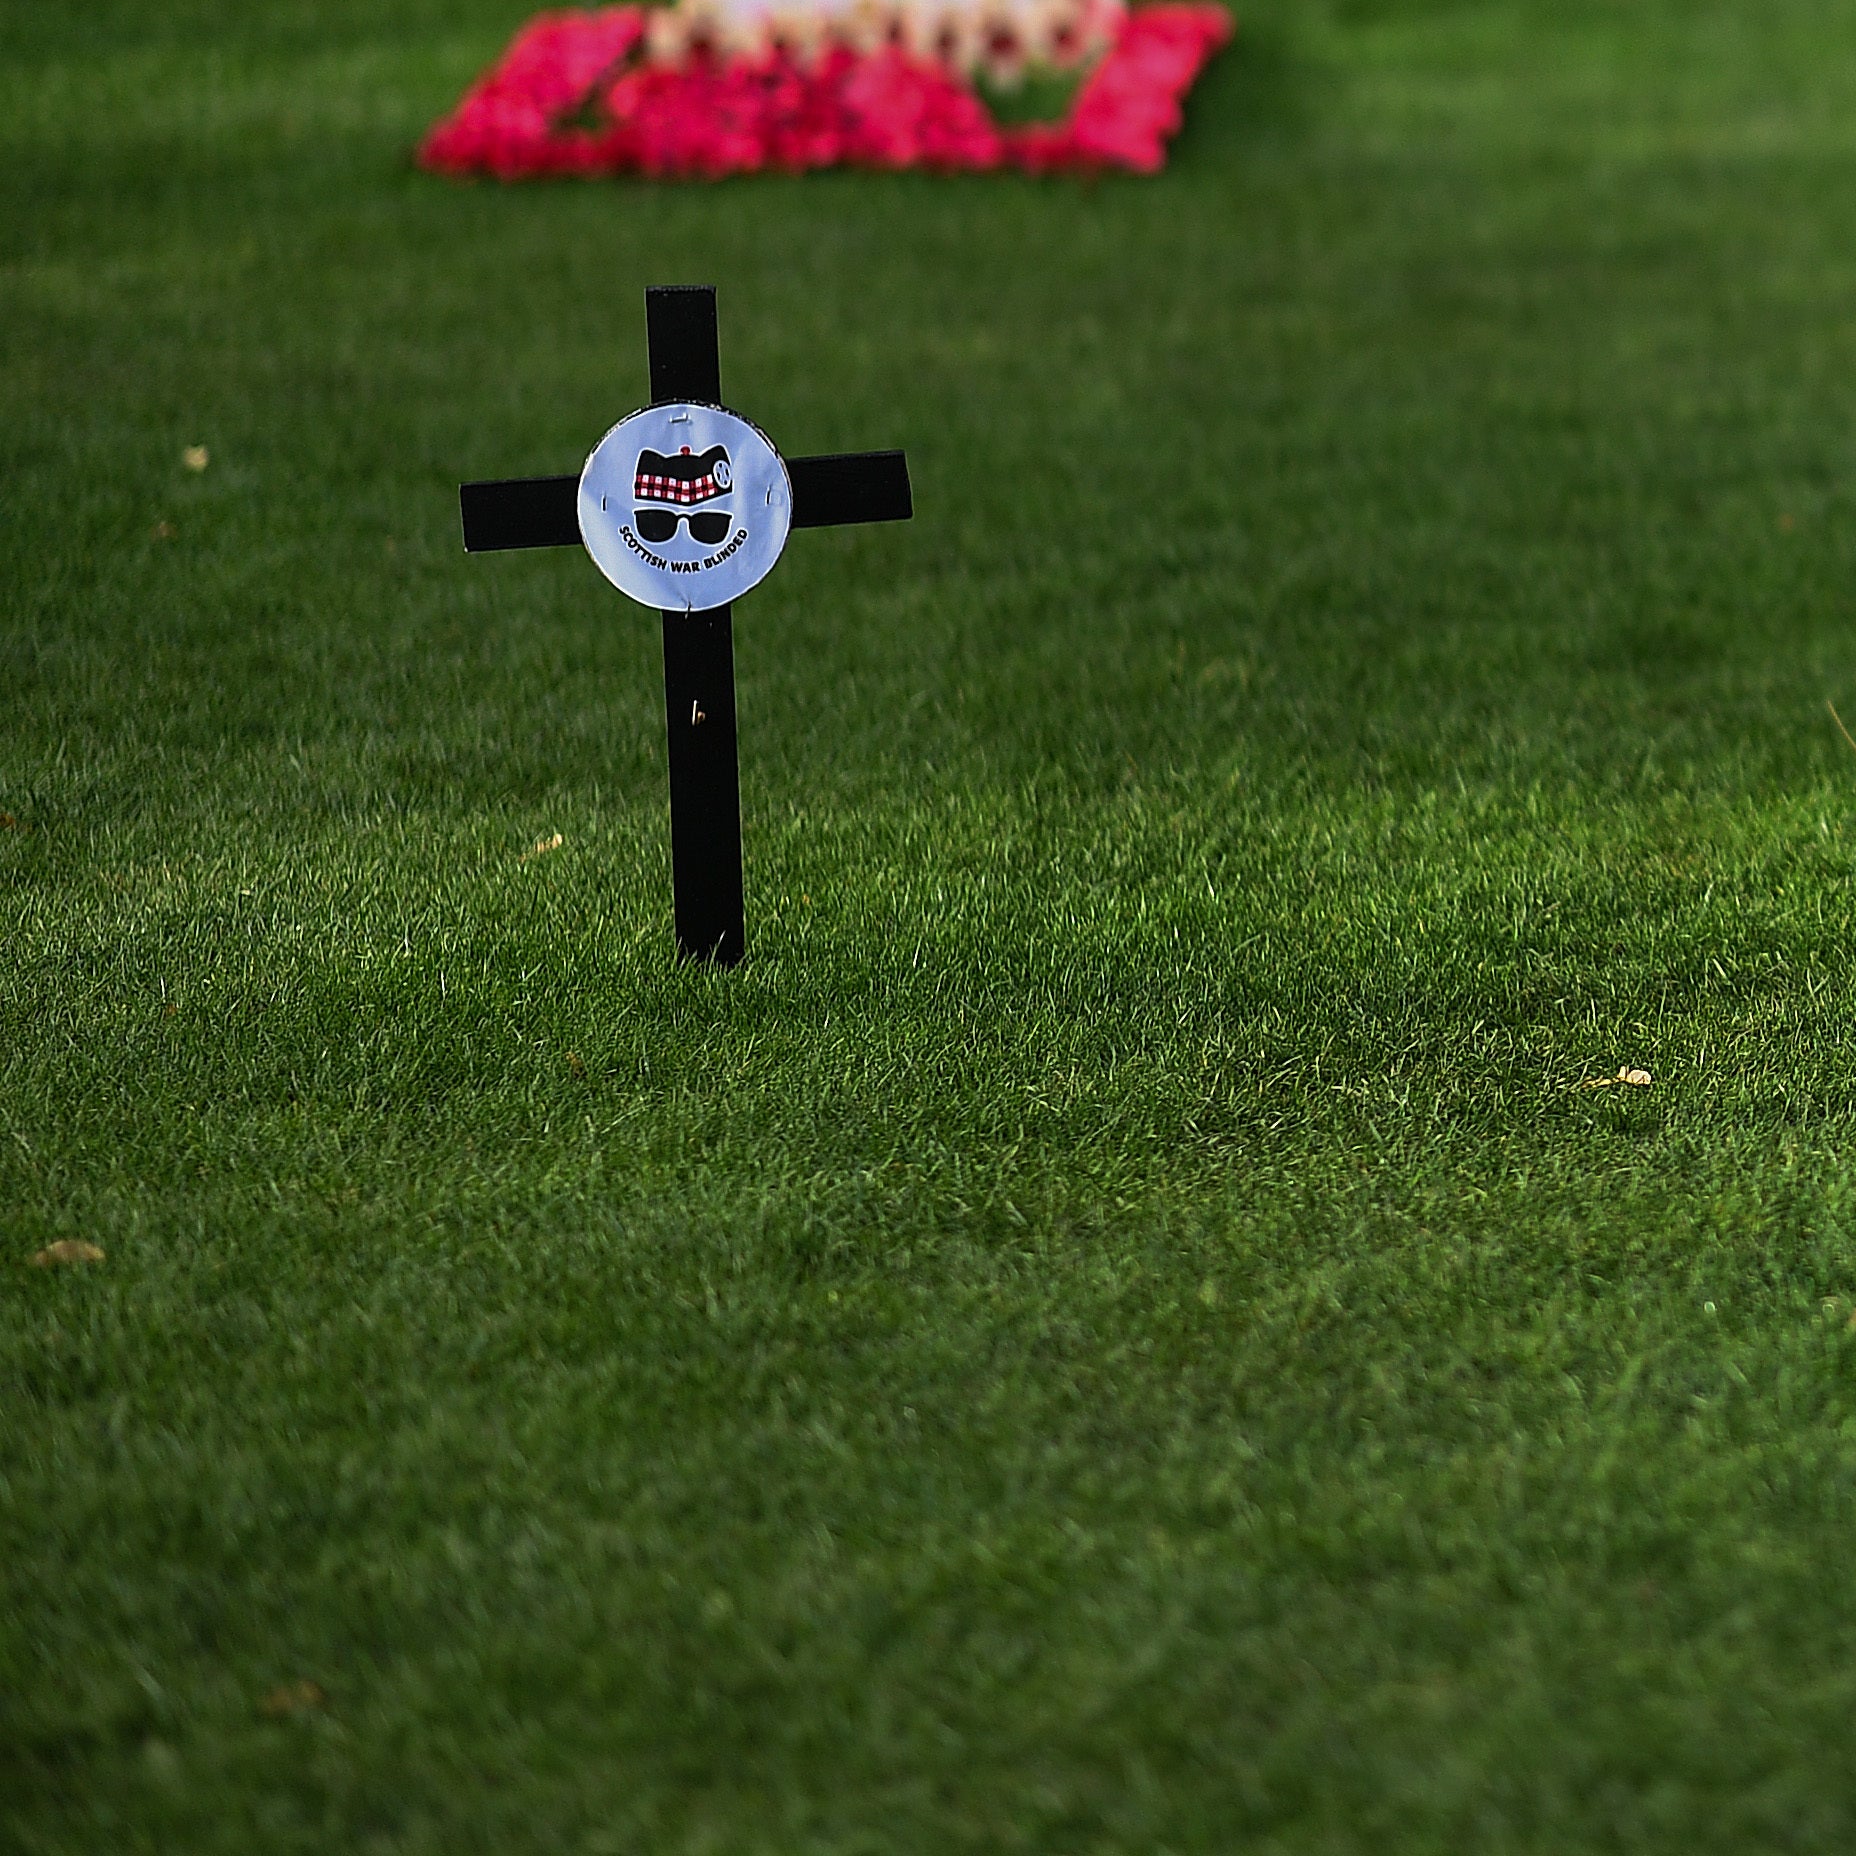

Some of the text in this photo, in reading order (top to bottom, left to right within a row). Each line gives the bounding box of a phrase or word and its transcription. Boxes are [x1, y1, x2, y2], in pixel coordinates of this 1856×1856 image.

[619, 526, 748, 573] SCOTTISH WAR BLINDED
